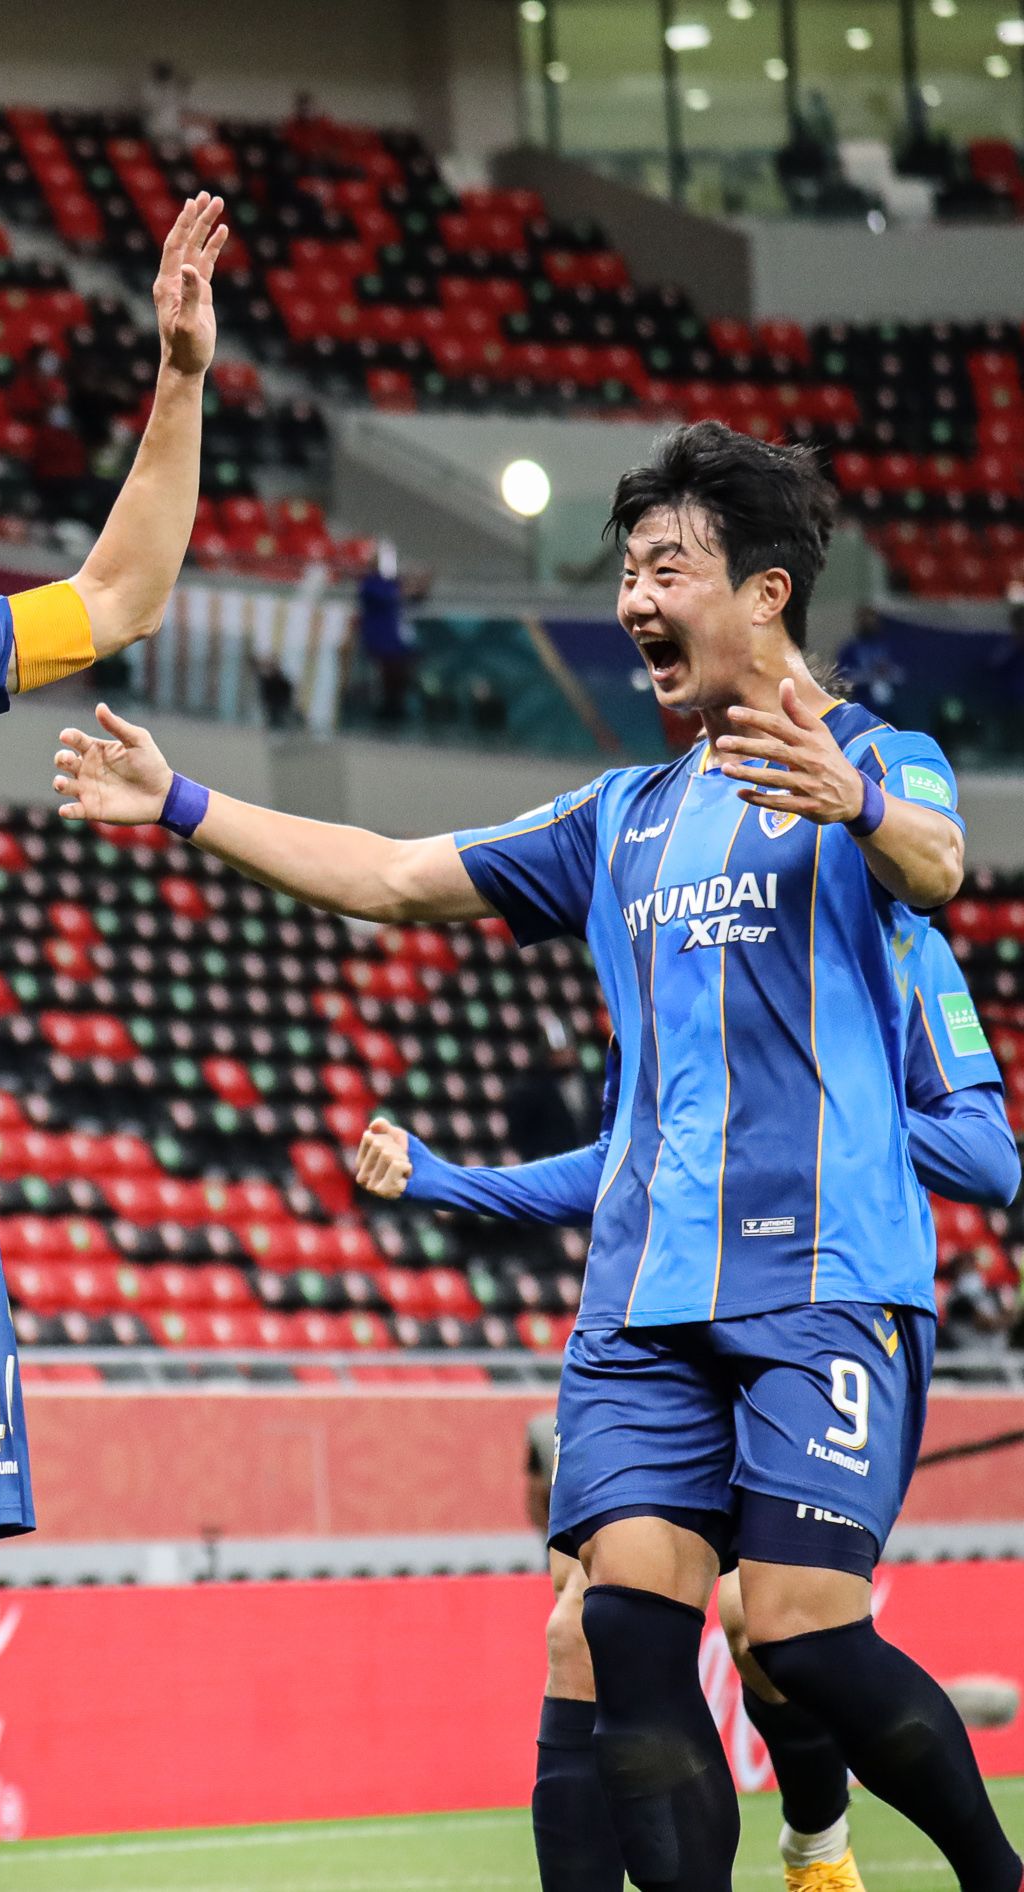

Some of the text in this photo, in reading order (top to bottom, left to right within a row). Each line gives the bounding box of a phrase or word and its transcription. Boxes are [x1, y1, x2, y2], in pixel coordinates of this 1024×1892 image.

[623, 872, 778, 942] HYUNDAI
[683, 913, 777, 950] XTeer
[825, 1358, 870, 1451] 9
[806, 1437, 870, 1477] hummel
